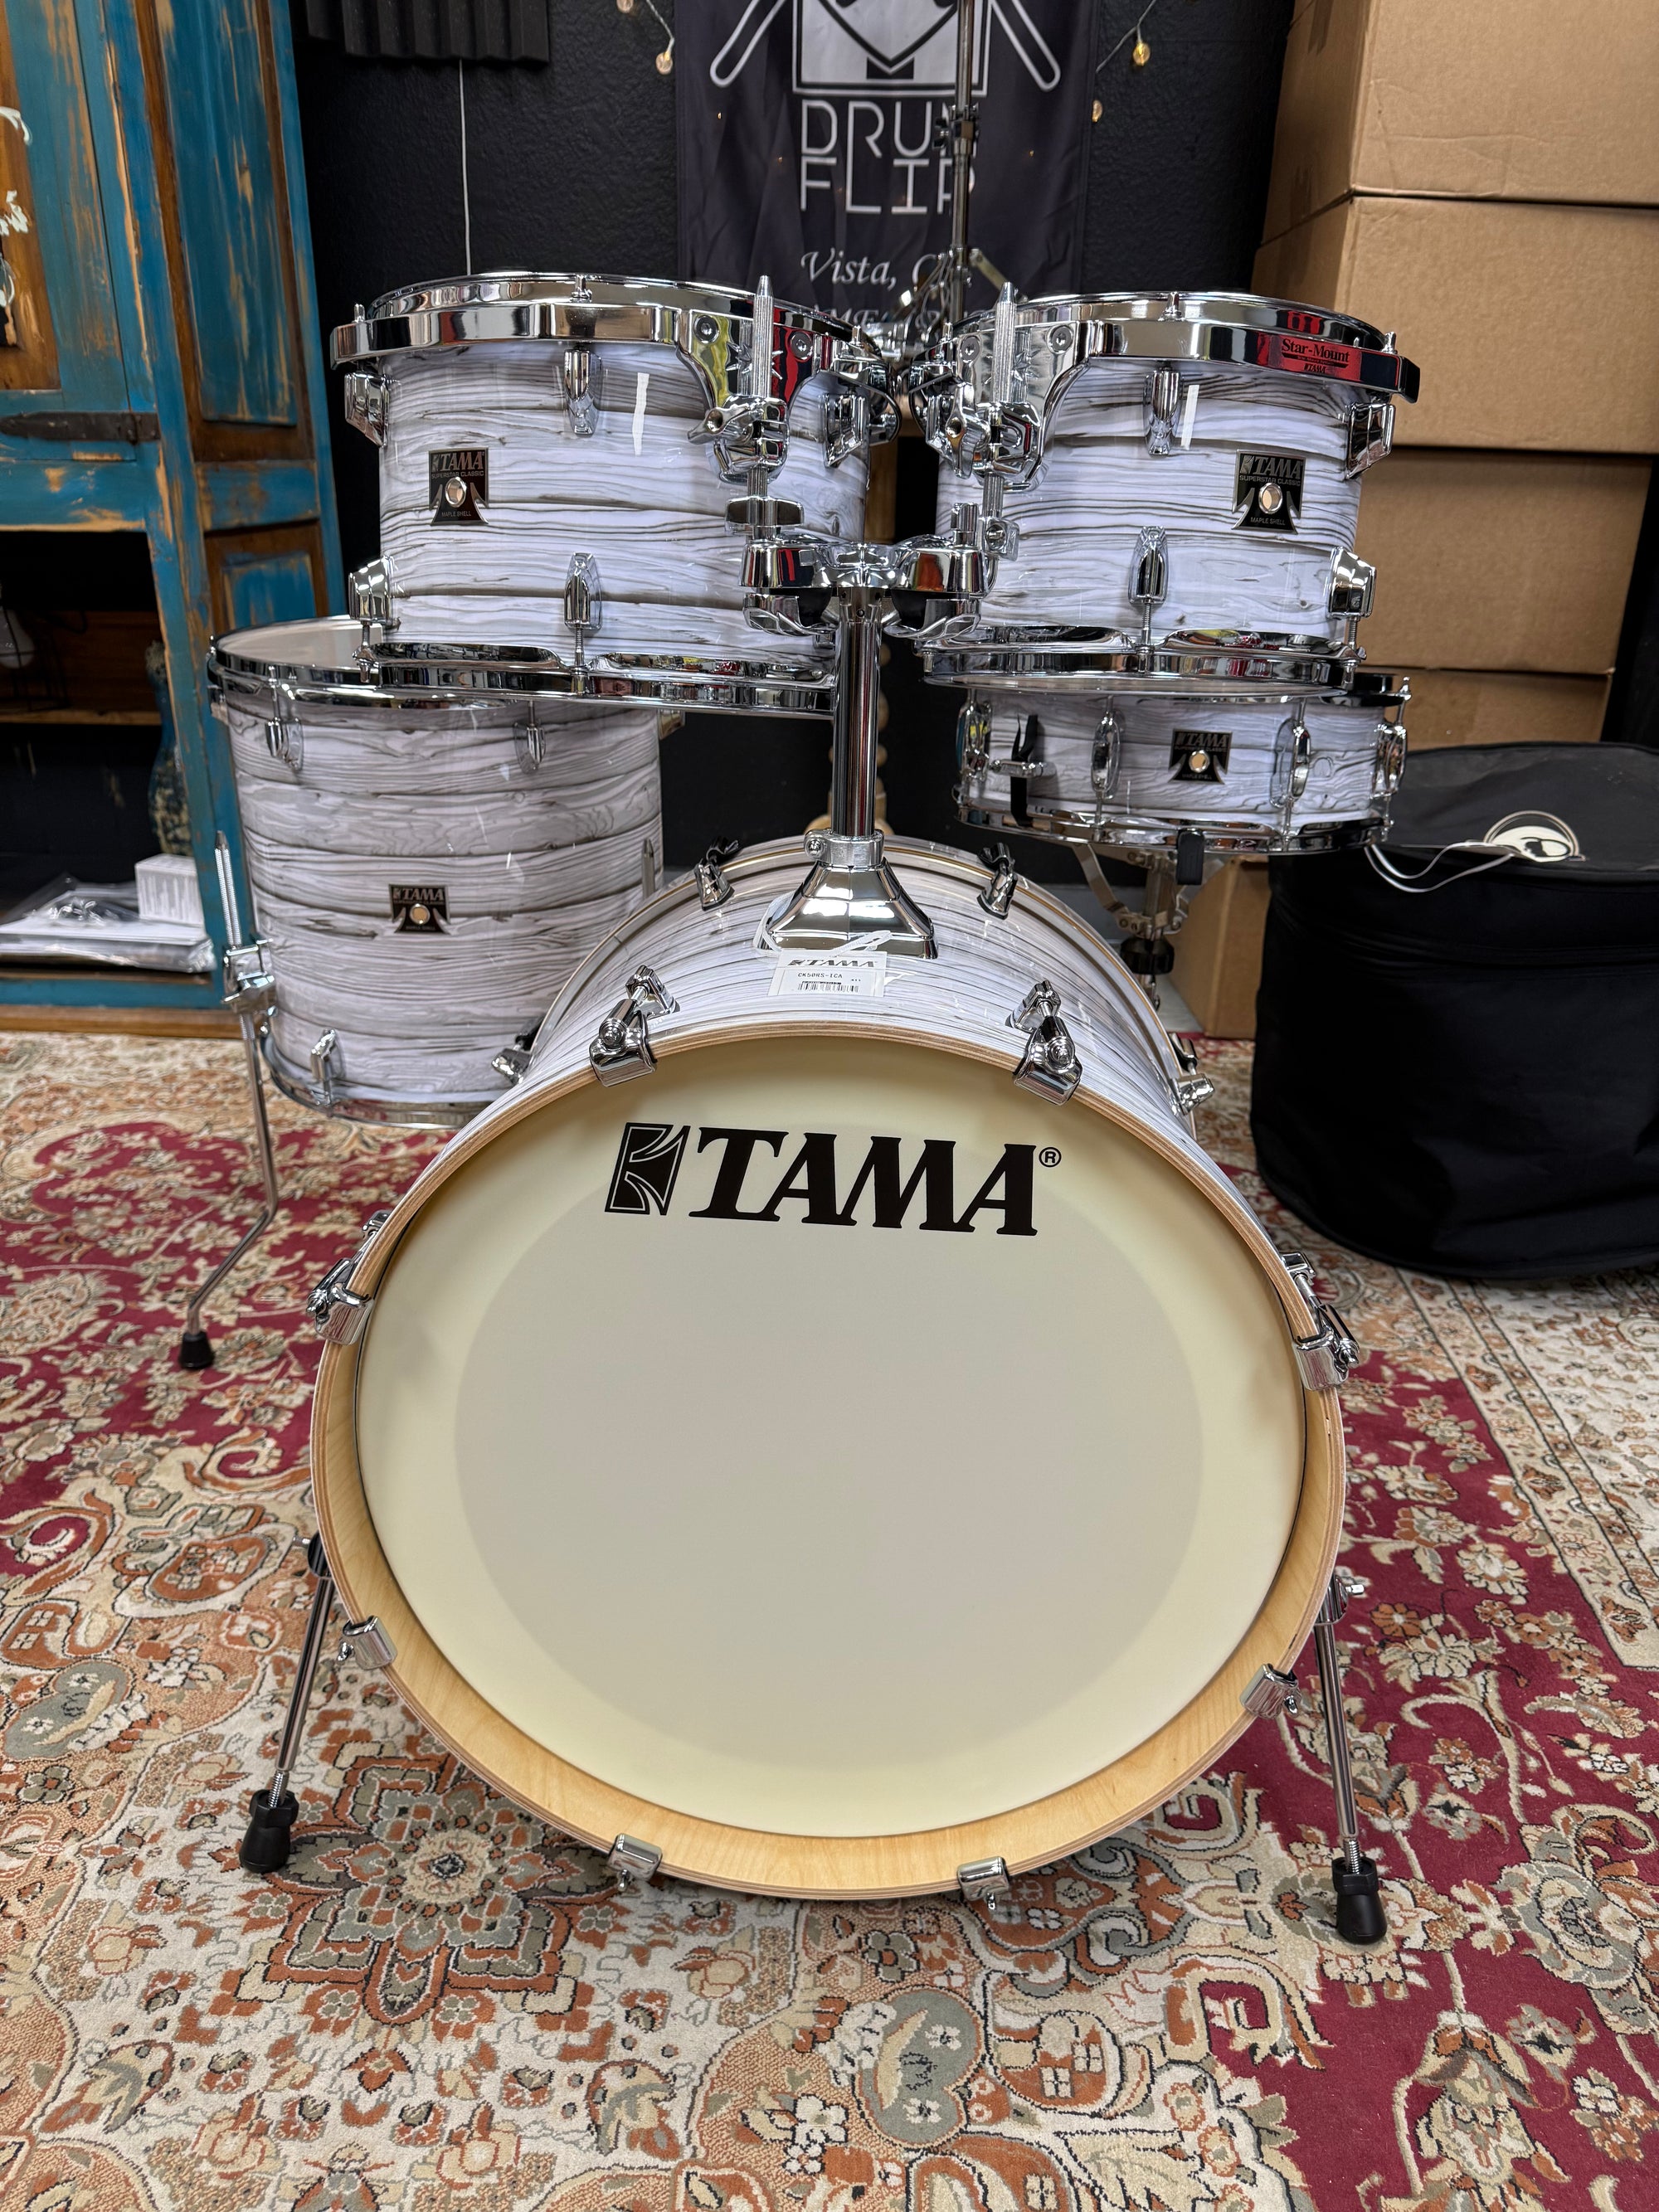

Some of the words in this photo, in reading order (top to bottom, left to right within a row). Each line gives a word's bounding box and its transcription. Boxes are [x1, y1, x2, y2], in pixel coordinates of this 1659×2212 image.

[800, 247, 897, 290] Vista,
[1281, 338, 1350, 362] Star-Mount
[431, 471, 460, 479] SUPERSTAR
[1253, 456, 1301, 480] TAMA
[1239, 474, 1277, 484] SUPERSTAR
[1277, 478, 1301, 487] CLASSIC
[1185, 732, 1228, 746] TAMA
[402, 887, 445, 901] TAMA
[805, 959, 874, 968] TAMA
